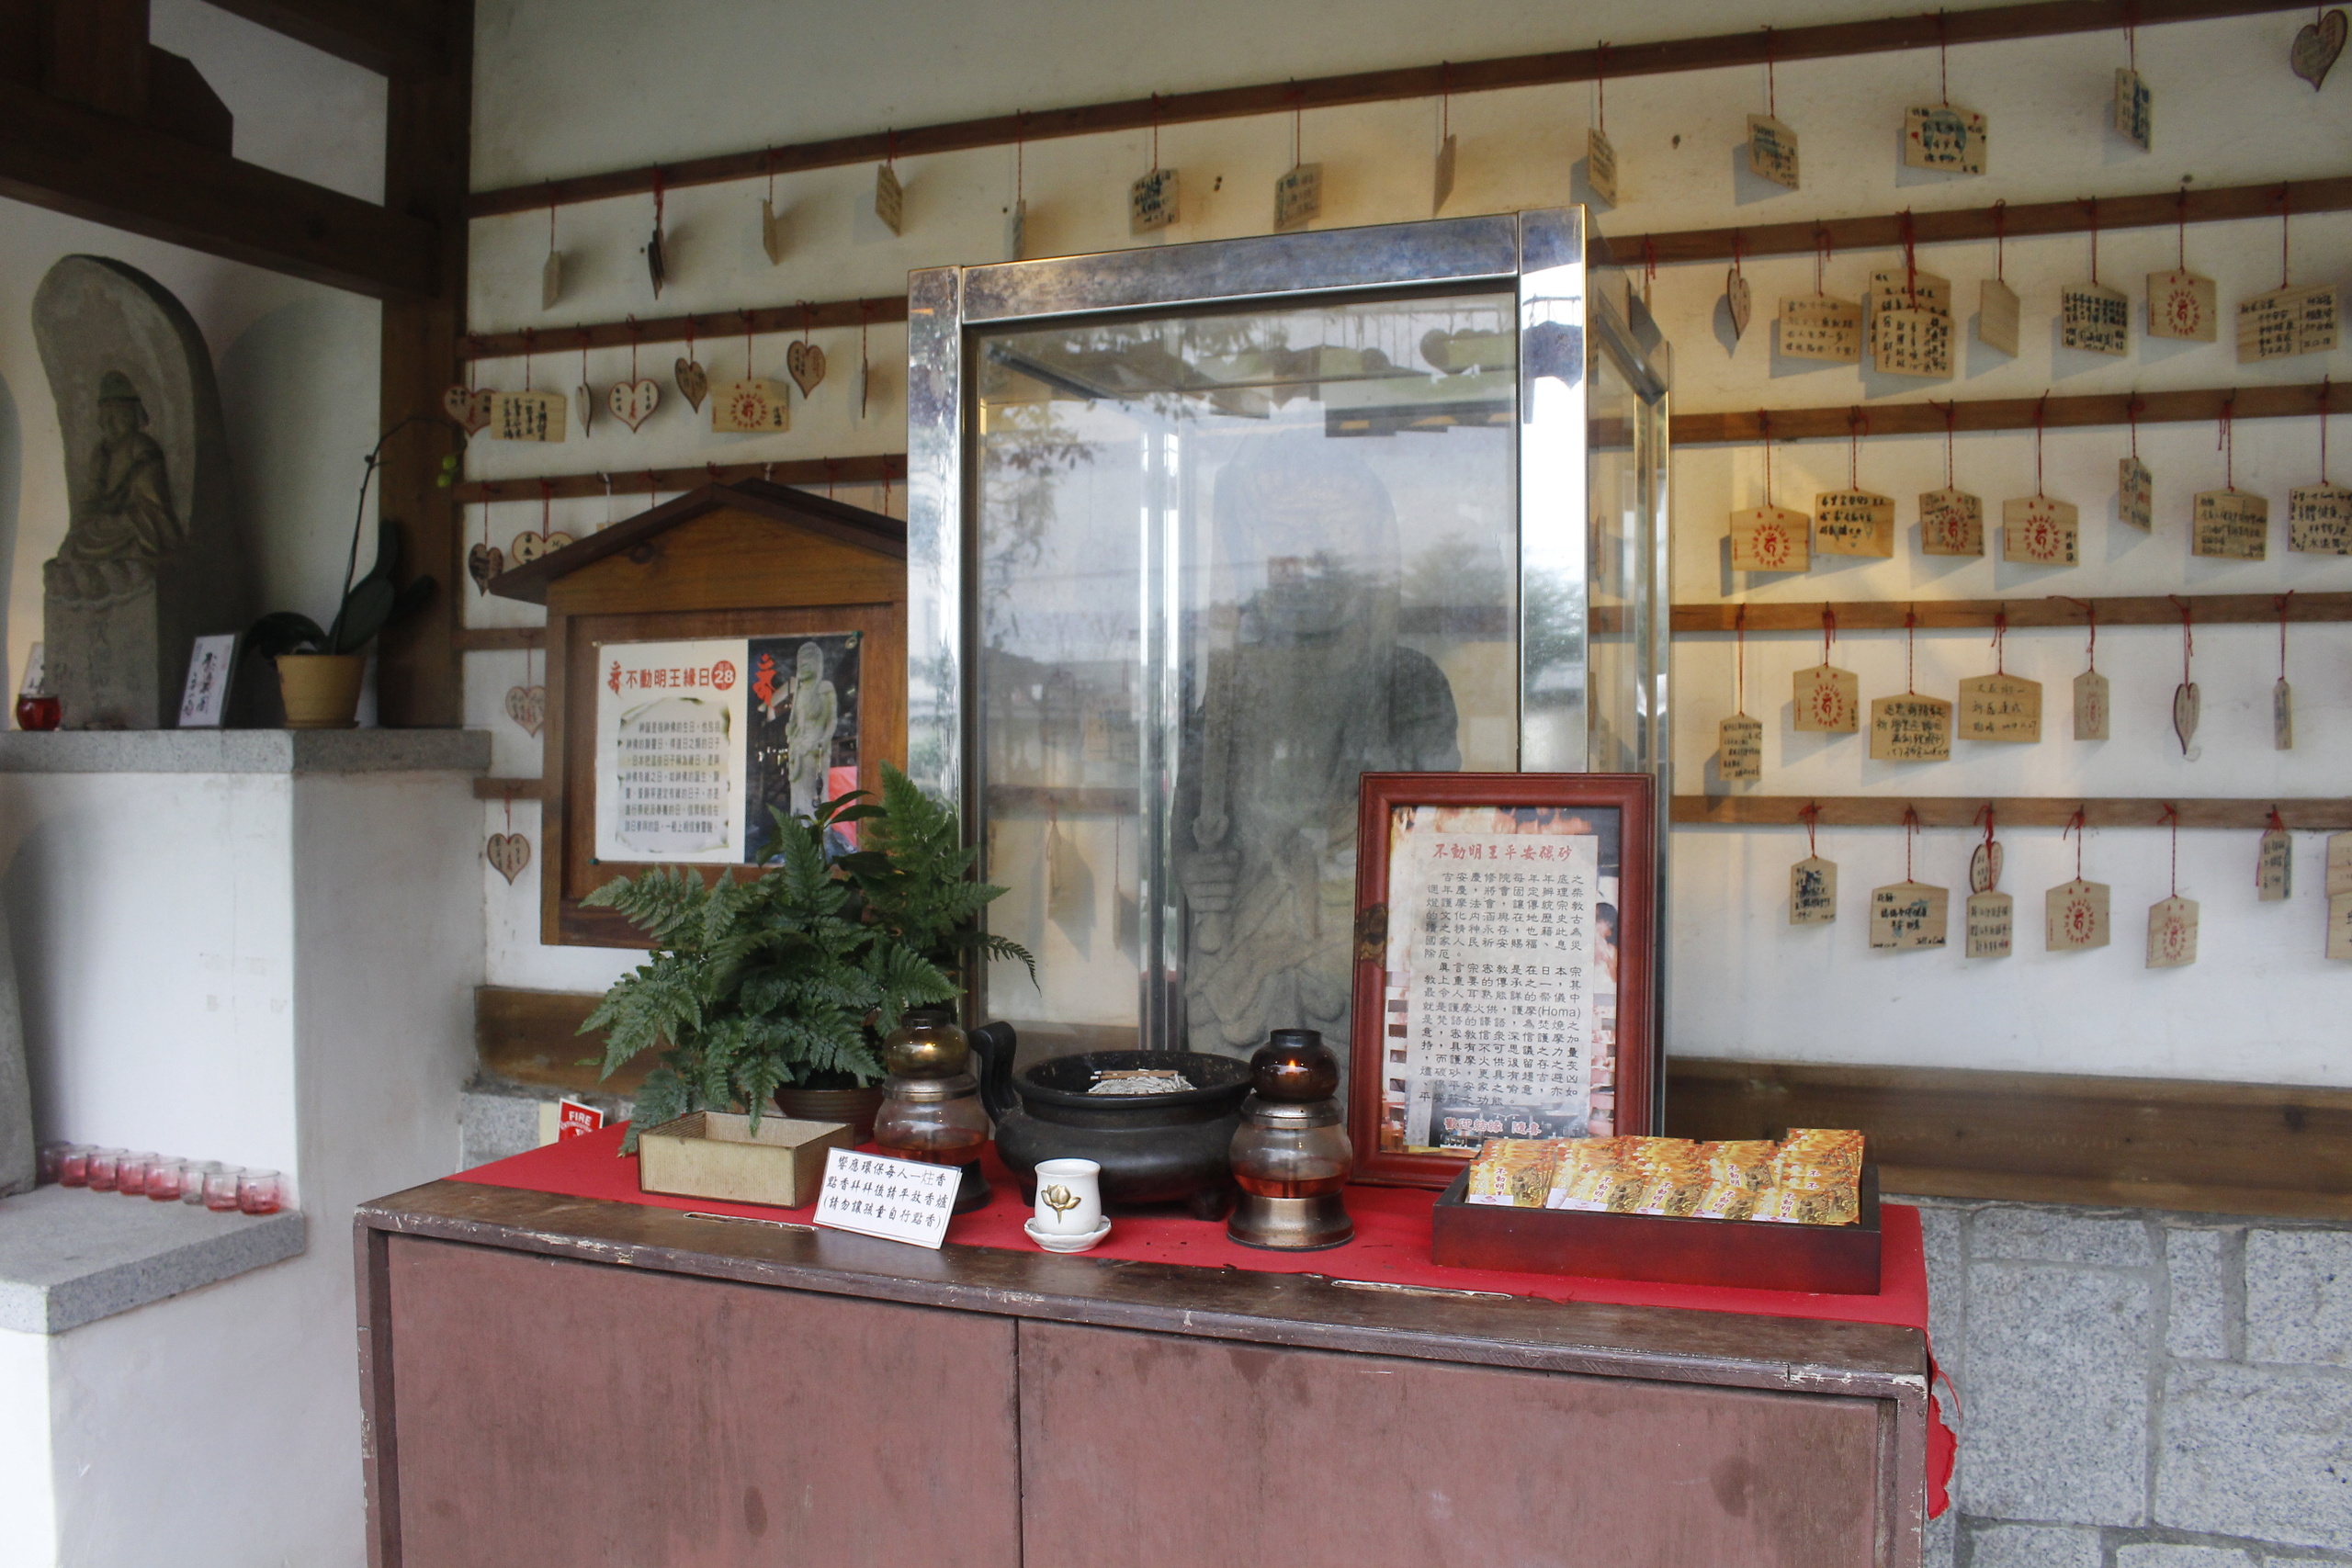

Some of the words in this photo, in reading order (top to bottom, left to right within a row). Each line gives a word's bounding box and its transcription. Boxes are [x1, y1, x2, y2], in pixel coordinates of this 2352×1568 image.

[626, 668, 709, 689] 不動明王緣日
[714, 670, 734, 684] 28
[1442, 873, 1584, 885] 吉安慶修院每年年底之
[1424, 975, 1581, 990] 教上重要的傳承之一，其
[1424, 987, 1580, 1003] 最令人耳熟能詳的祭儀中
[569, 1111, 593, 1127] FIRE
[1444, 1116, 1504, 1134] 歡迎結緣
[1512, 1122, 1542, 1136] 隨喜
[838, 1156, 946, 1188] 響應環保每人一炷香
[826, 1176, 948, 1209] 點香拜拜後請平放香爐
